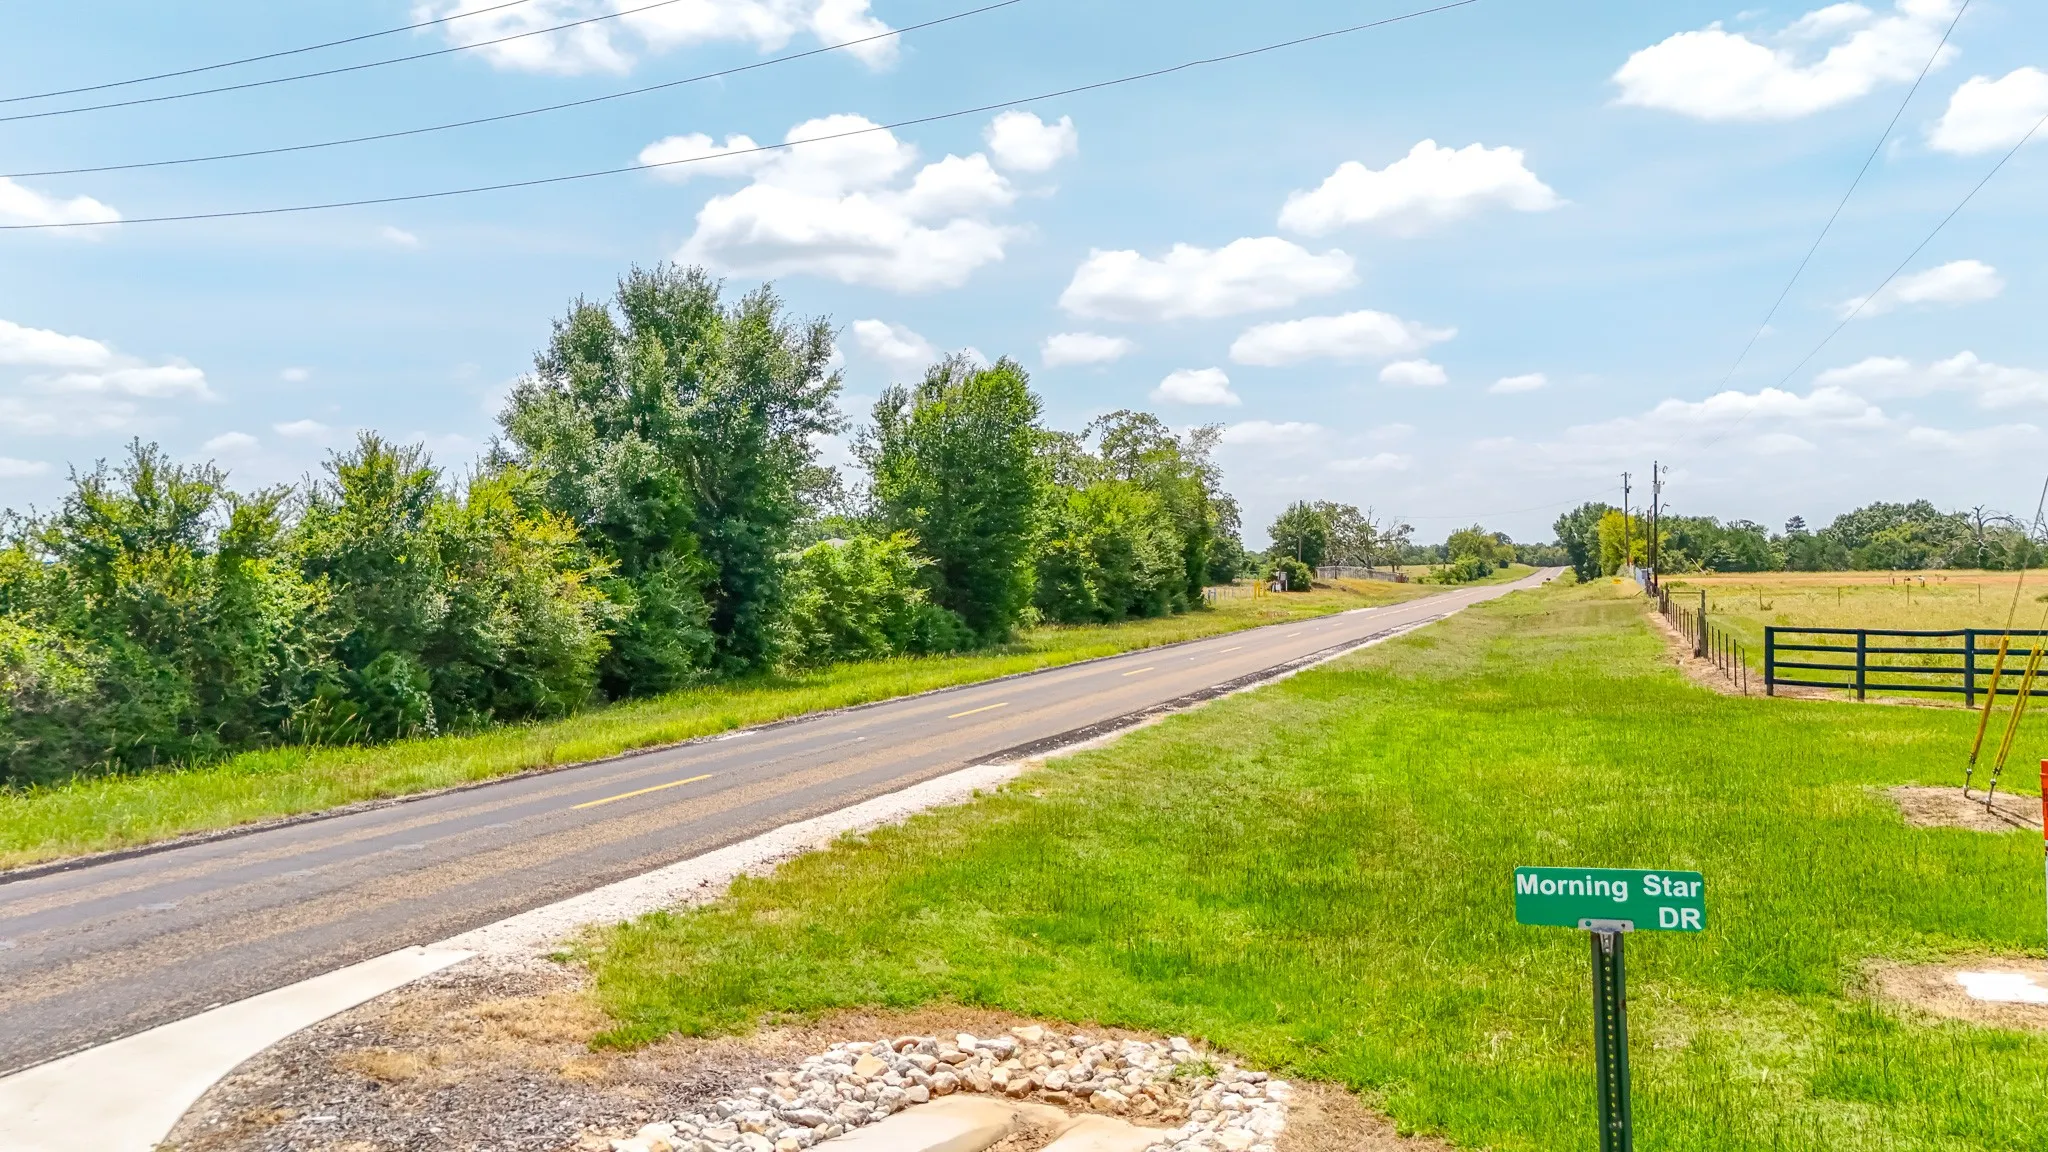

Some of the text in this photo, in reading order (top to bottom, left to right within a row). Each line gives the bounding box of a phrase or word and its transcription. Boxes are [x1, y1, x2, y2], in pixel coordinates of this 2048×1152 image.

[1516, 873, 1701, 902] Morning Star
[1659, 907, 1702, 930] DR
